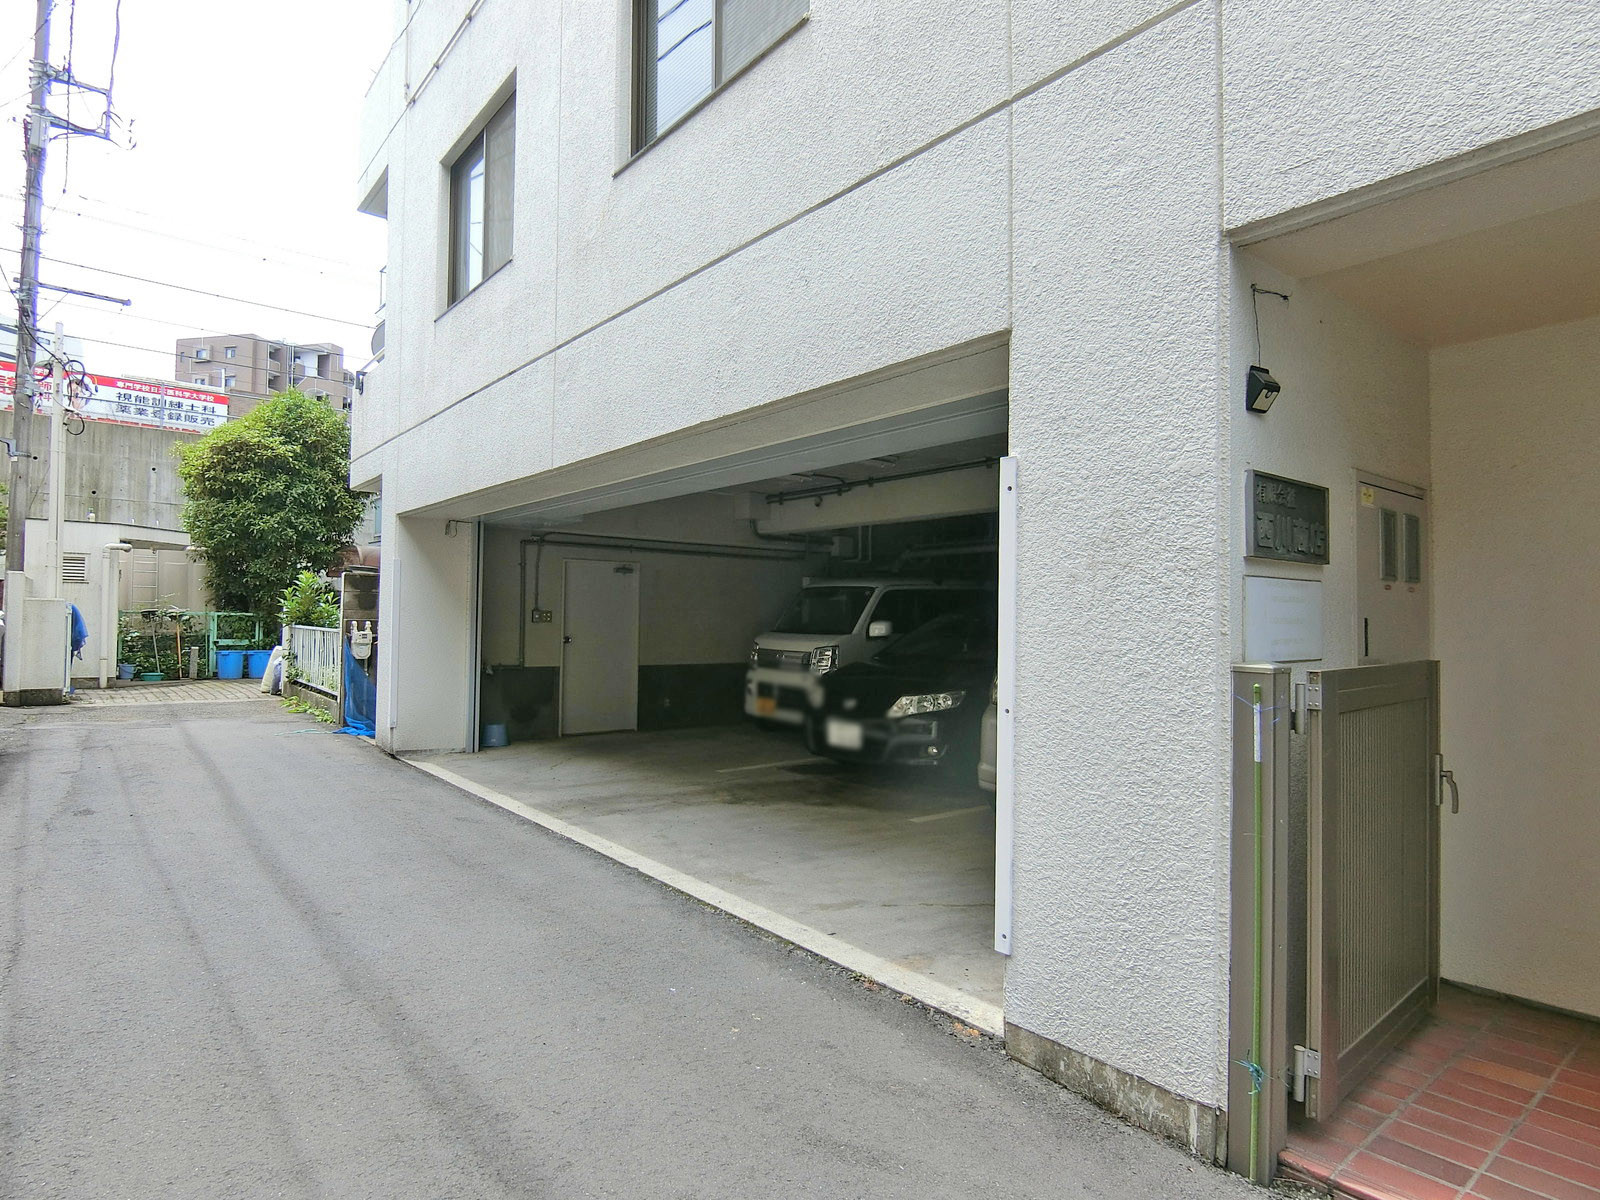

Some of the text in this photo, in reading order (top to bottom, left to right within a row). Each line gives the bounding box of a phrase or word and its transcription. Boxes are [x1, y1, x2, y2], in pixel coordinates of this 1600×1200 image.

[116, 391, 217, 414] 視能訓練士科
